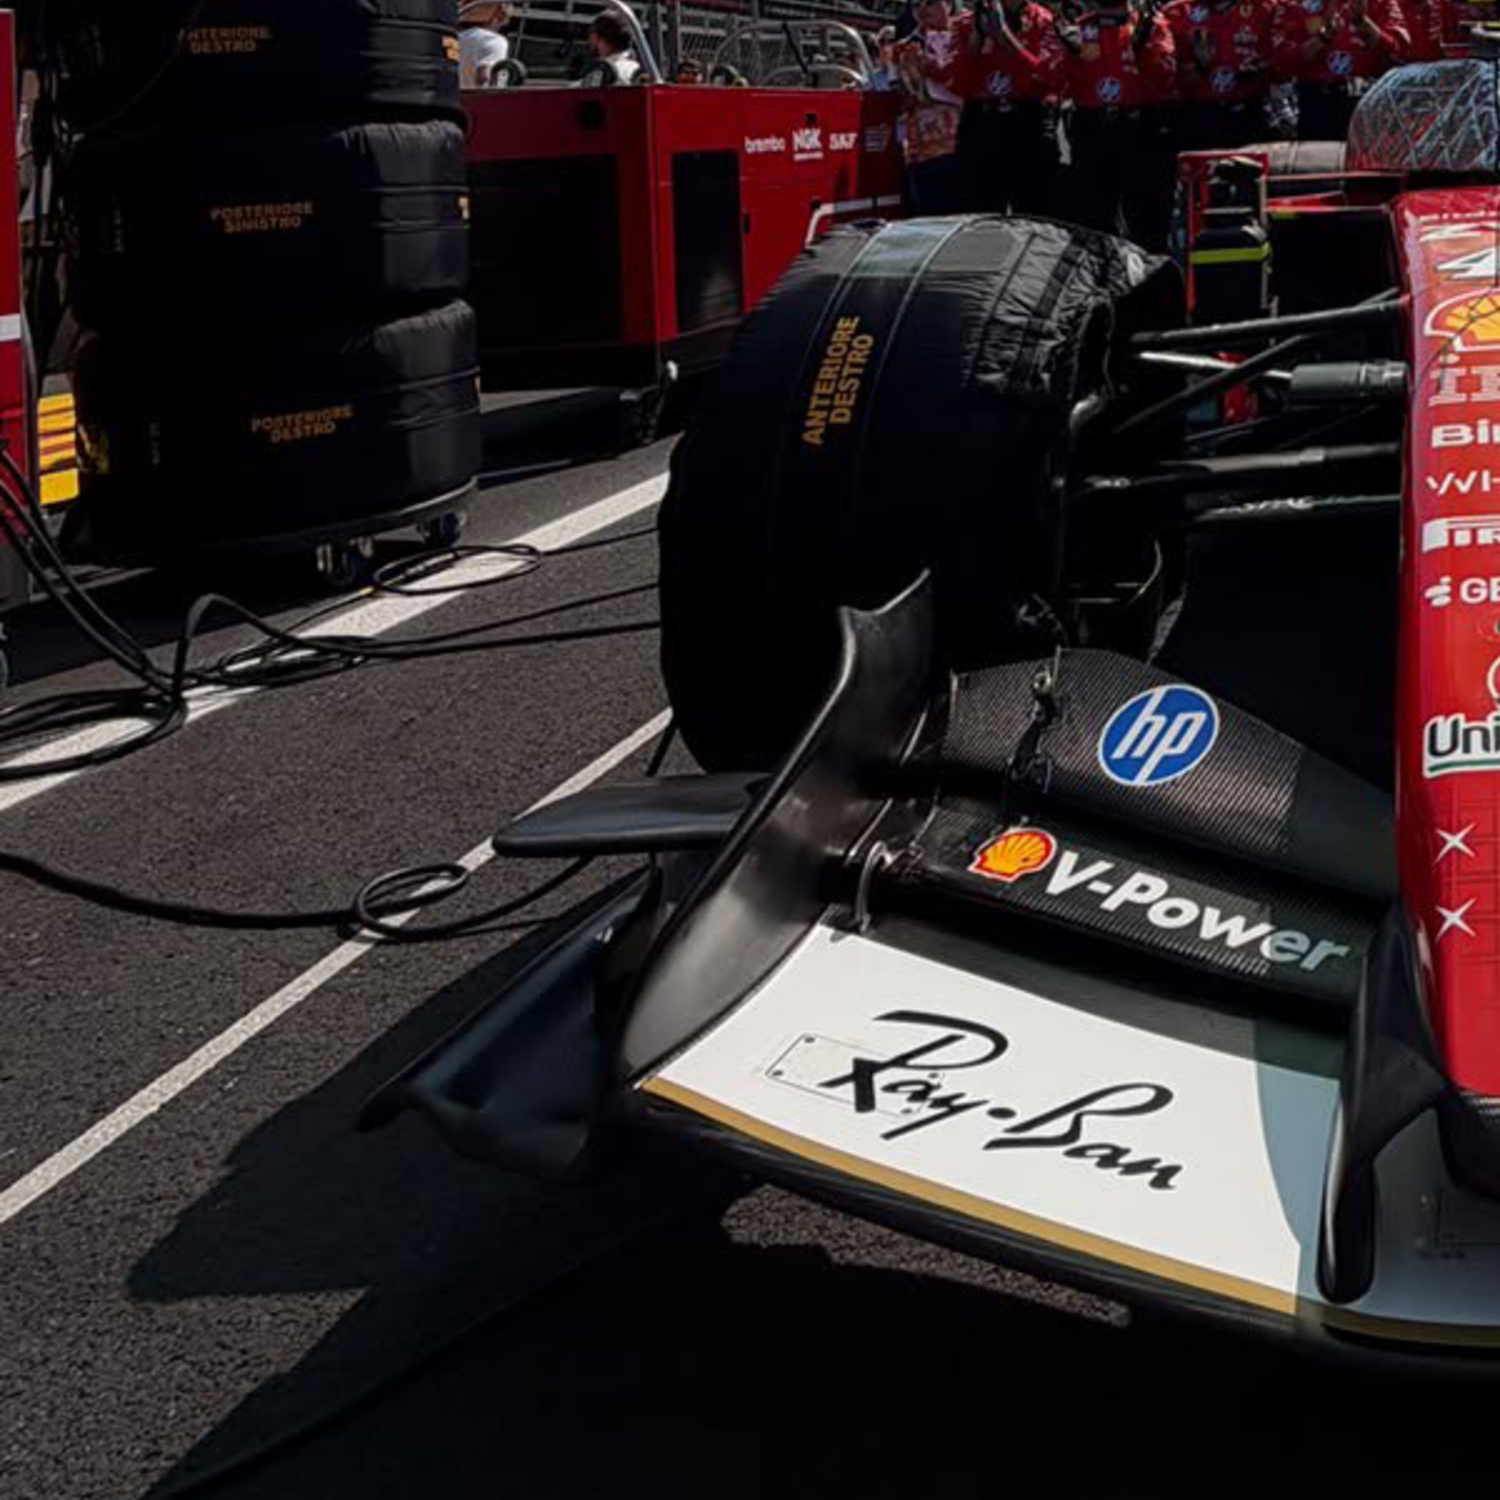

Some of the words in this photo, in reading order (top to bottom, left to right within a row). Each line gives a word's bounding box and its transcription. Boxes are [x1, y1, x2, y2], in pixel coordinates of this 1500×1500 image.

[801, 315, 861, 446] ANTERIORE
[829, 334, 875, 426] DESTRO
[1110, 686, 1208, 785] hp
[1045, 850, 1350, 971] V-Power
[817, 1009, 1183, 1190] Ray-Ban
